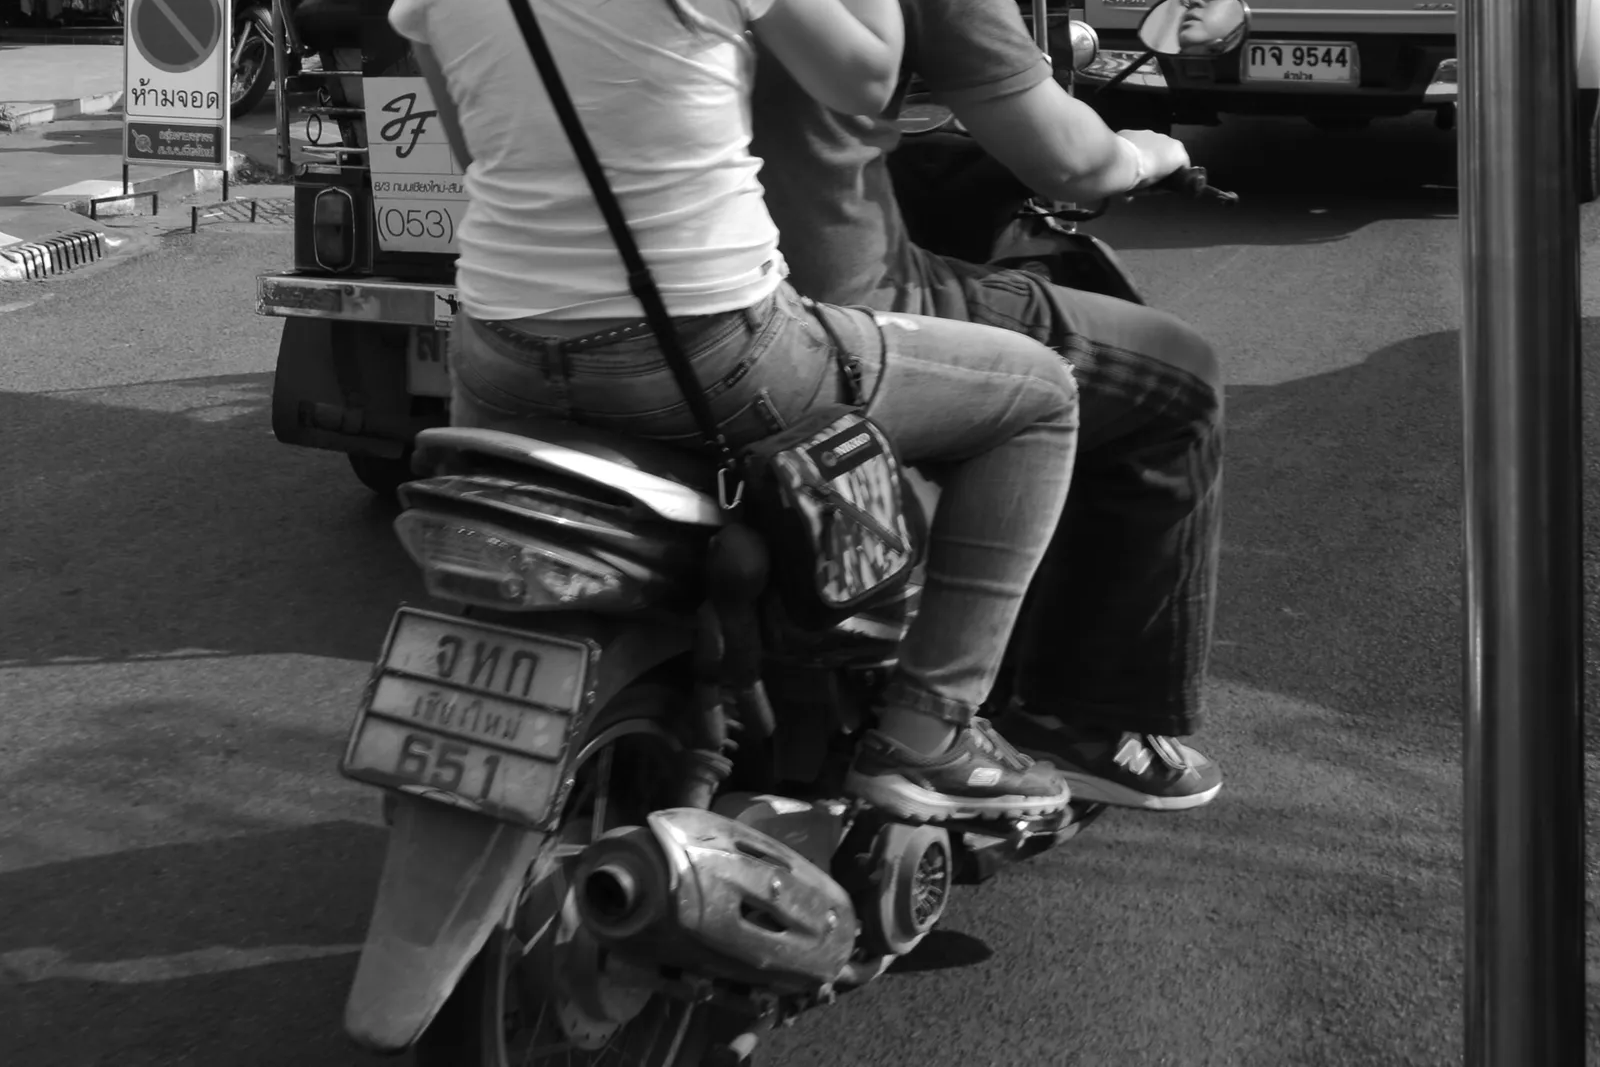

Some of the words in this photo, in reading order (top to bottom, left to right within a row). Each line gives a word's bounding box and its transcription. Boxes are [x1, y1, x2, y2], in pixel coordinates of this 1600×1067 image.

[1251, 45, 1283, 67] กจ
[1292, 46, 1348, 68] 9544
[131, 77, 219, 109] ห้ามจอด
[374, 180, 391, 192] 8/3
[377, 206, 454, 244] (053)
[400, 733, 503, 801] 651
